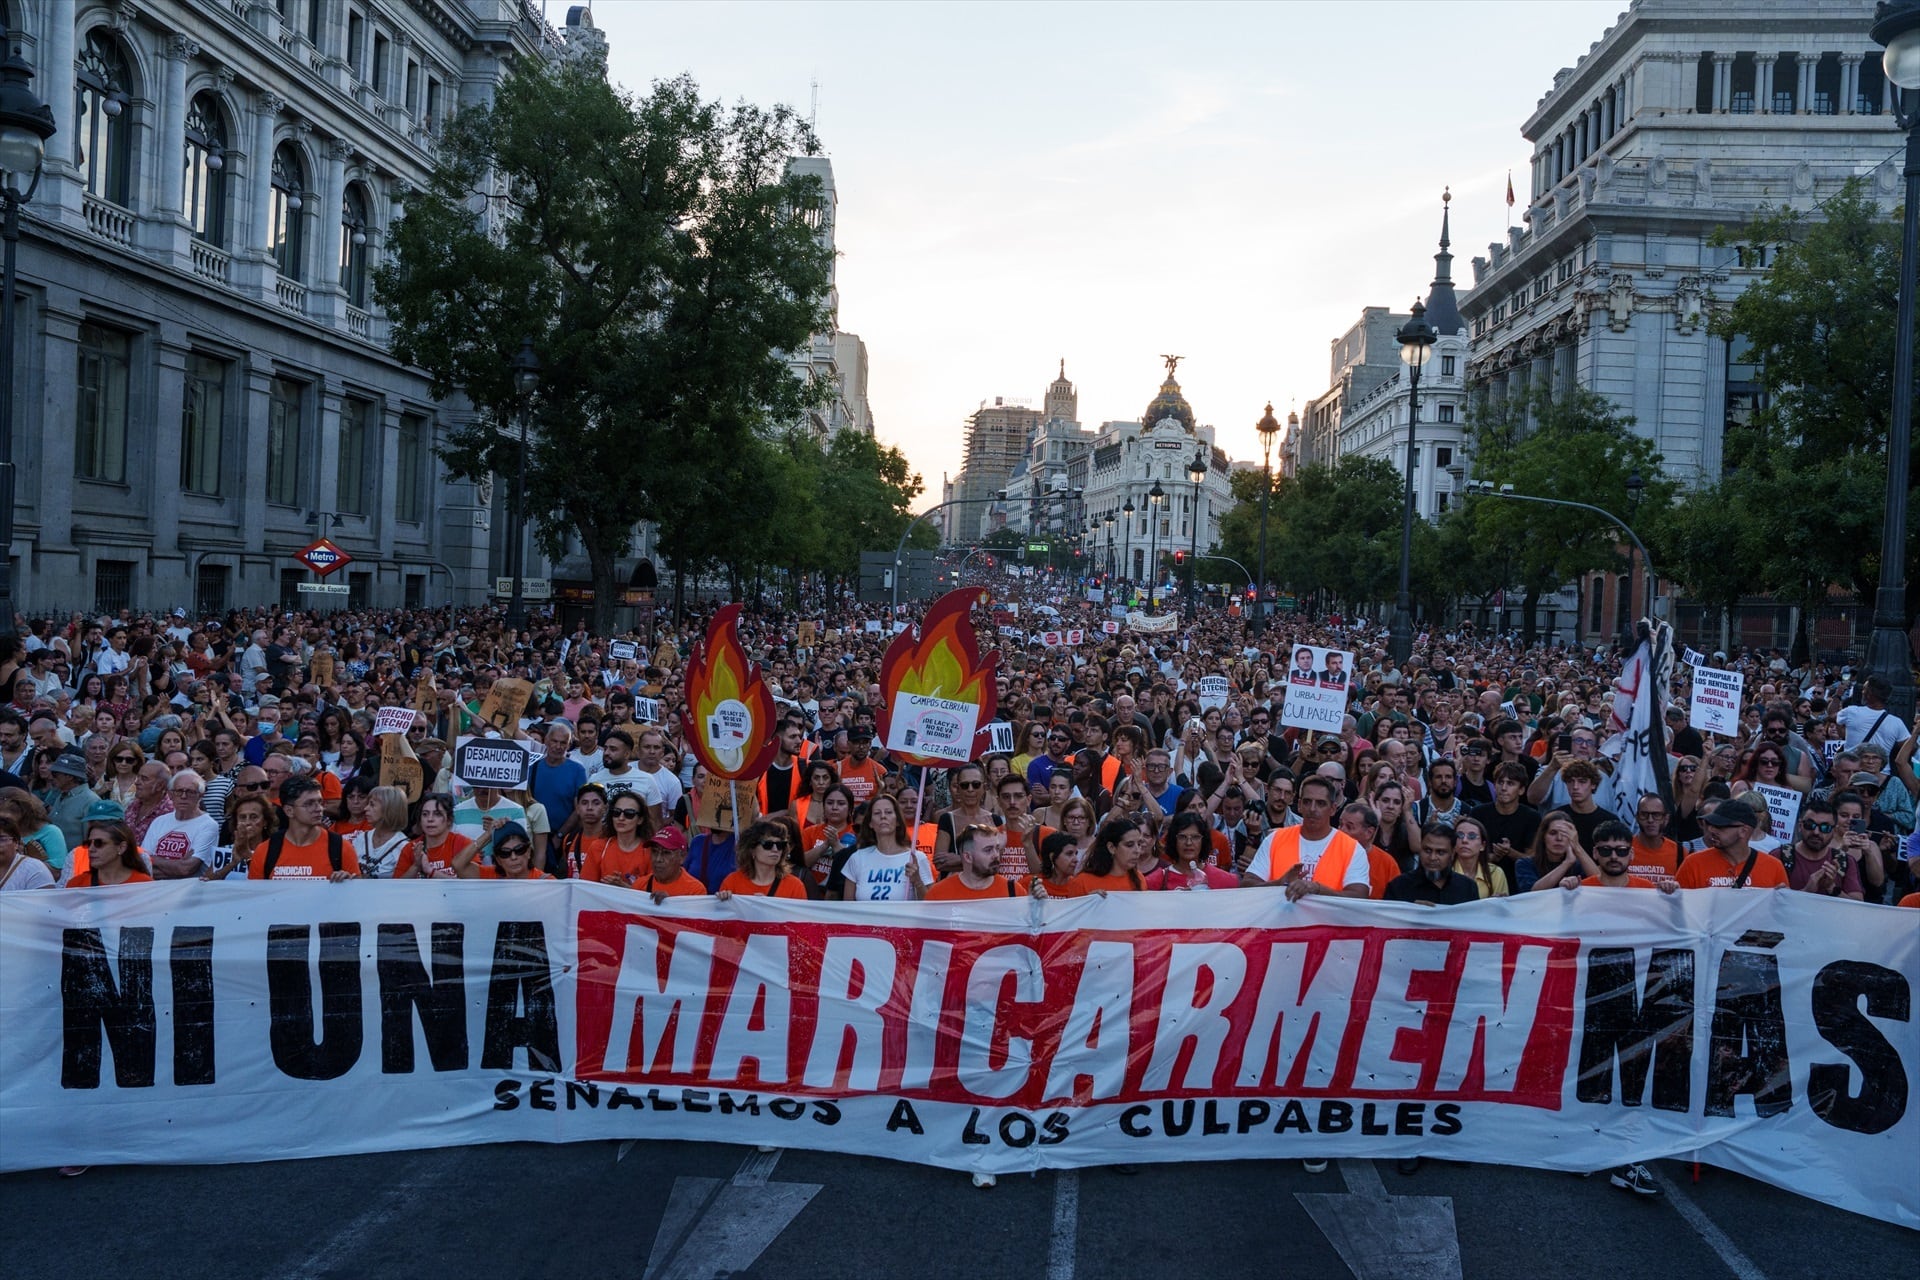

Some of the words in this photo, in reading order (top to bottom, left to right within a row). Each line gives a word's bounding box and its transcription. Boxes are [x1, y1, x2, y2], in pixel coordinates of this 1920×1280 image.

[310, 553, 335, 562] Metro
[1202, 678, 1227, 686] DERECHO
[1699, 670, 1731, 682] EXPROPIAR
[1707, 680, 1740, 692] RENTISTAS
[1704, 688, 1729, 699] HUELGA
[911, 696, 939, 708] CAMPOS
[1697, 696, 1724, 707] GENERAL
[1727, 702, 1735, 710] YA
[378, 709, 414, 721] DERECHO
[1284, 703, 1342, 724] CULPABLES
[381, 718, 410, 730] TECHO
[935, 720, 950, 728] LACY
[997, 728, 1013, 751] NO
[466, 747, 523, 764] DESAHUCIOS
[464, 765, 521, 780] INFAMES!!!
[1770, 798, 1782, 806] LOS
[159, 840, 186, 852] STOP
[274, 866, 312, 876] SINDICATO
[867, 867, 905, 884] LACY,
[1627, 865, 1665, 874] SINDICATO
[870, 885, 893, 901] 22
[61, 924, 216, 1090] NI
[267, 920, 562, 1081] UNA
[602, 922, 1554, 1102] MARICARMEN
[1576, 929, 1911, 1135] MÁS
[886, 1098, 925, 1135] A
[962, 1106, 1071, 1149] LOS
[1119, 1098, 1464, 1138] CULPABLES
